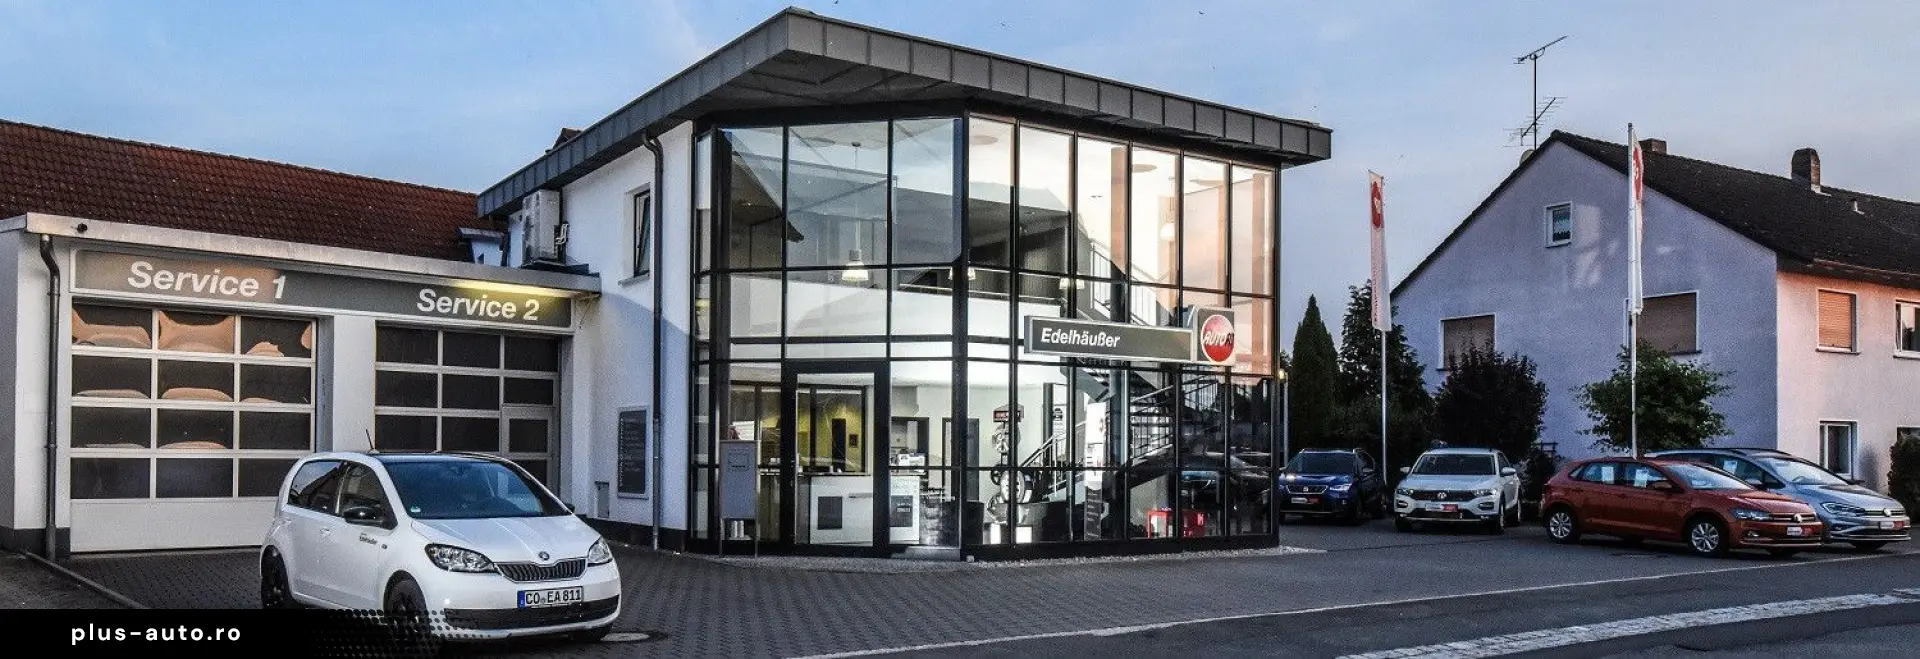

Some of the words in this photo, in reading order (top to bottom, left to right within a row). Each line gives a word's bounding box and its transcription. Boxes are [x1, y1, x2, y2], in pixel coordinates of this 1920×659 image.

[127, 260, 260, 298] Service
[272, 274, 287, 300] 1
[416, 288, 517, 319] Service
[523, 299, 540, 321] 2
[1040, 327, 1121, 348] Edelhäußer
[526, 592, 540, 604] CO
[547, 590, 561, 603] EA
[562, 590, 580, 601] 811
